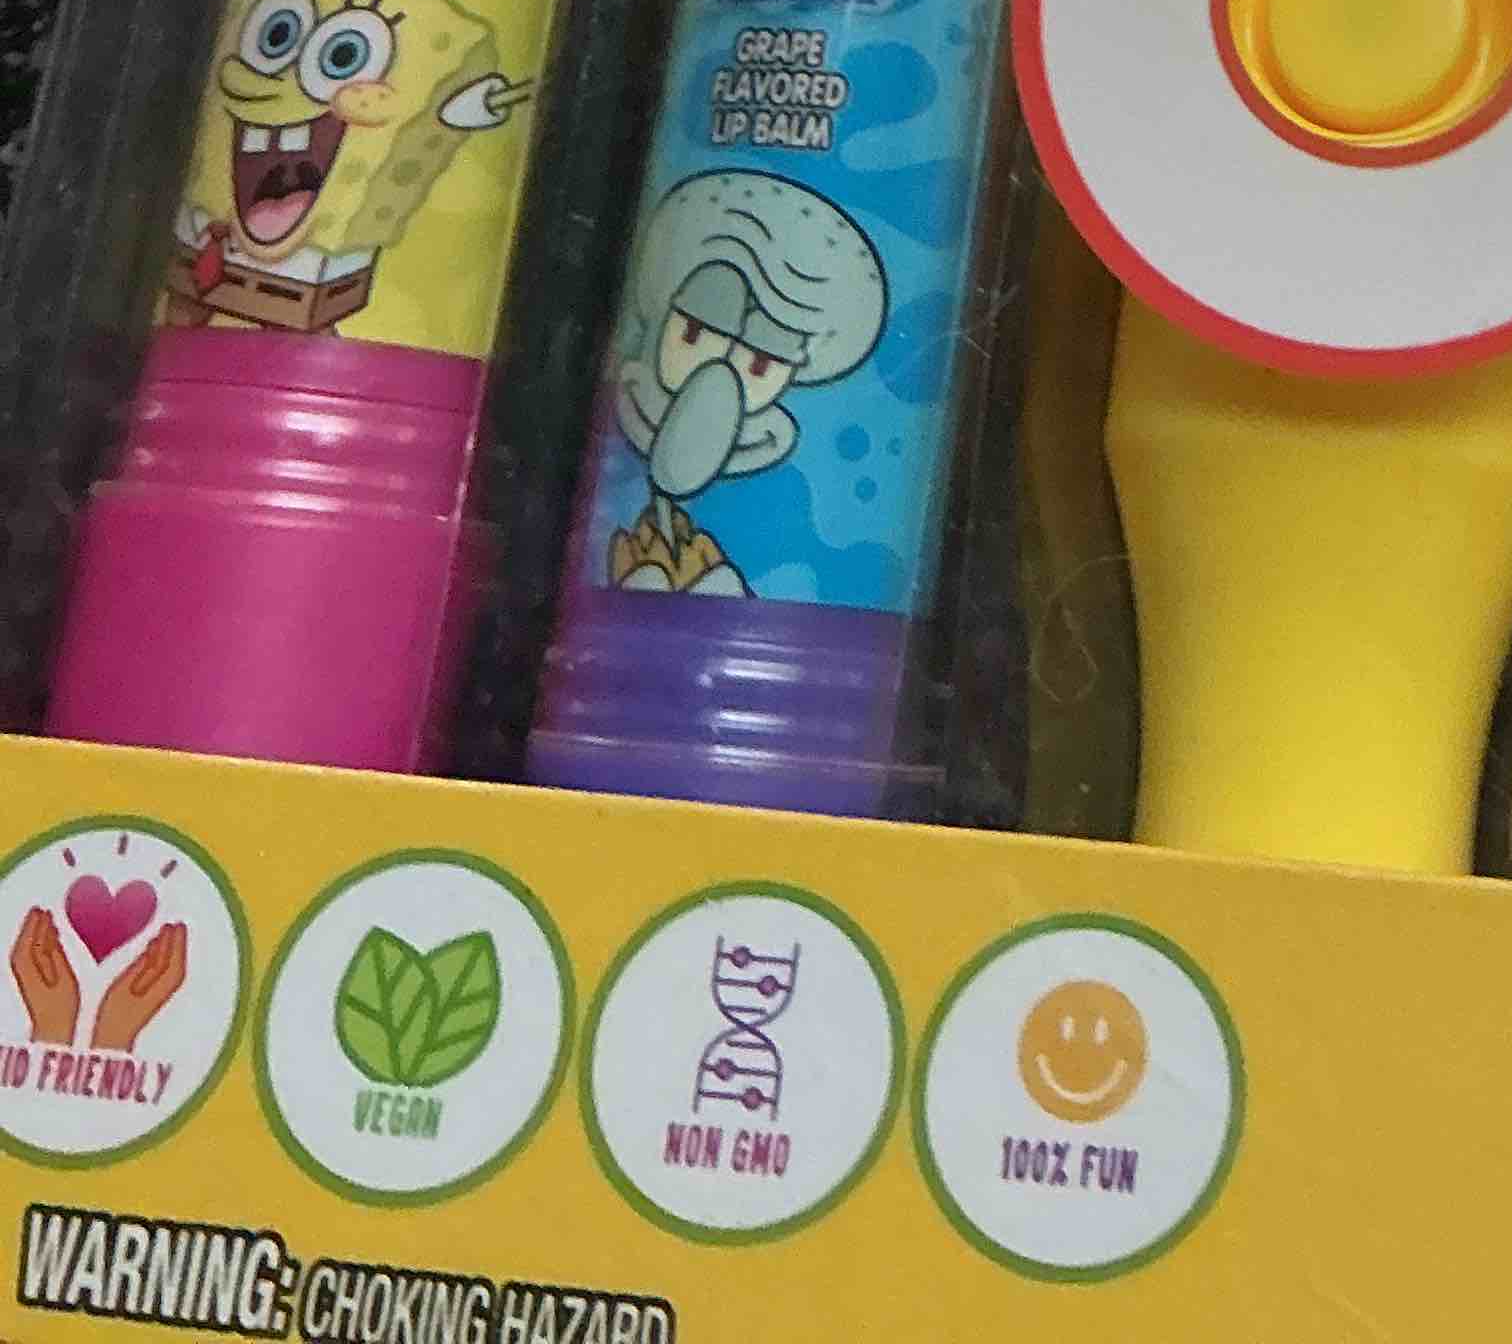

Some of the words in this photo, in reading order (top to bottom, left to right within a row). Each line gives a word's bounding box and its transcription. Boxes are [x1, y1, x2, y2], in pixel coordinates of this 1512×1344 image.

[735, 28, 826, 65] GRAPE
[710, 66, 848, 110] FLAVORED
[710, 107, 747, 144] LIP
[750, 111, 833, 150] BALM
[0, 1046, 29, 1088] ID
[37, 1050, 173, 1105] FRIENDLY
[352, 1090, 443, 1140] VEGAN
[662, 1123, 722, 1168] NON
[731, 1130, 792, 1177] GMO
[1001, 1137, 1069, 1187] 100%
[1080, 1145, 1139, 1193] FUN
[18, 1203, 300, 1337] WARNING:
[302, 1258, 497, 1344] CHOKING
